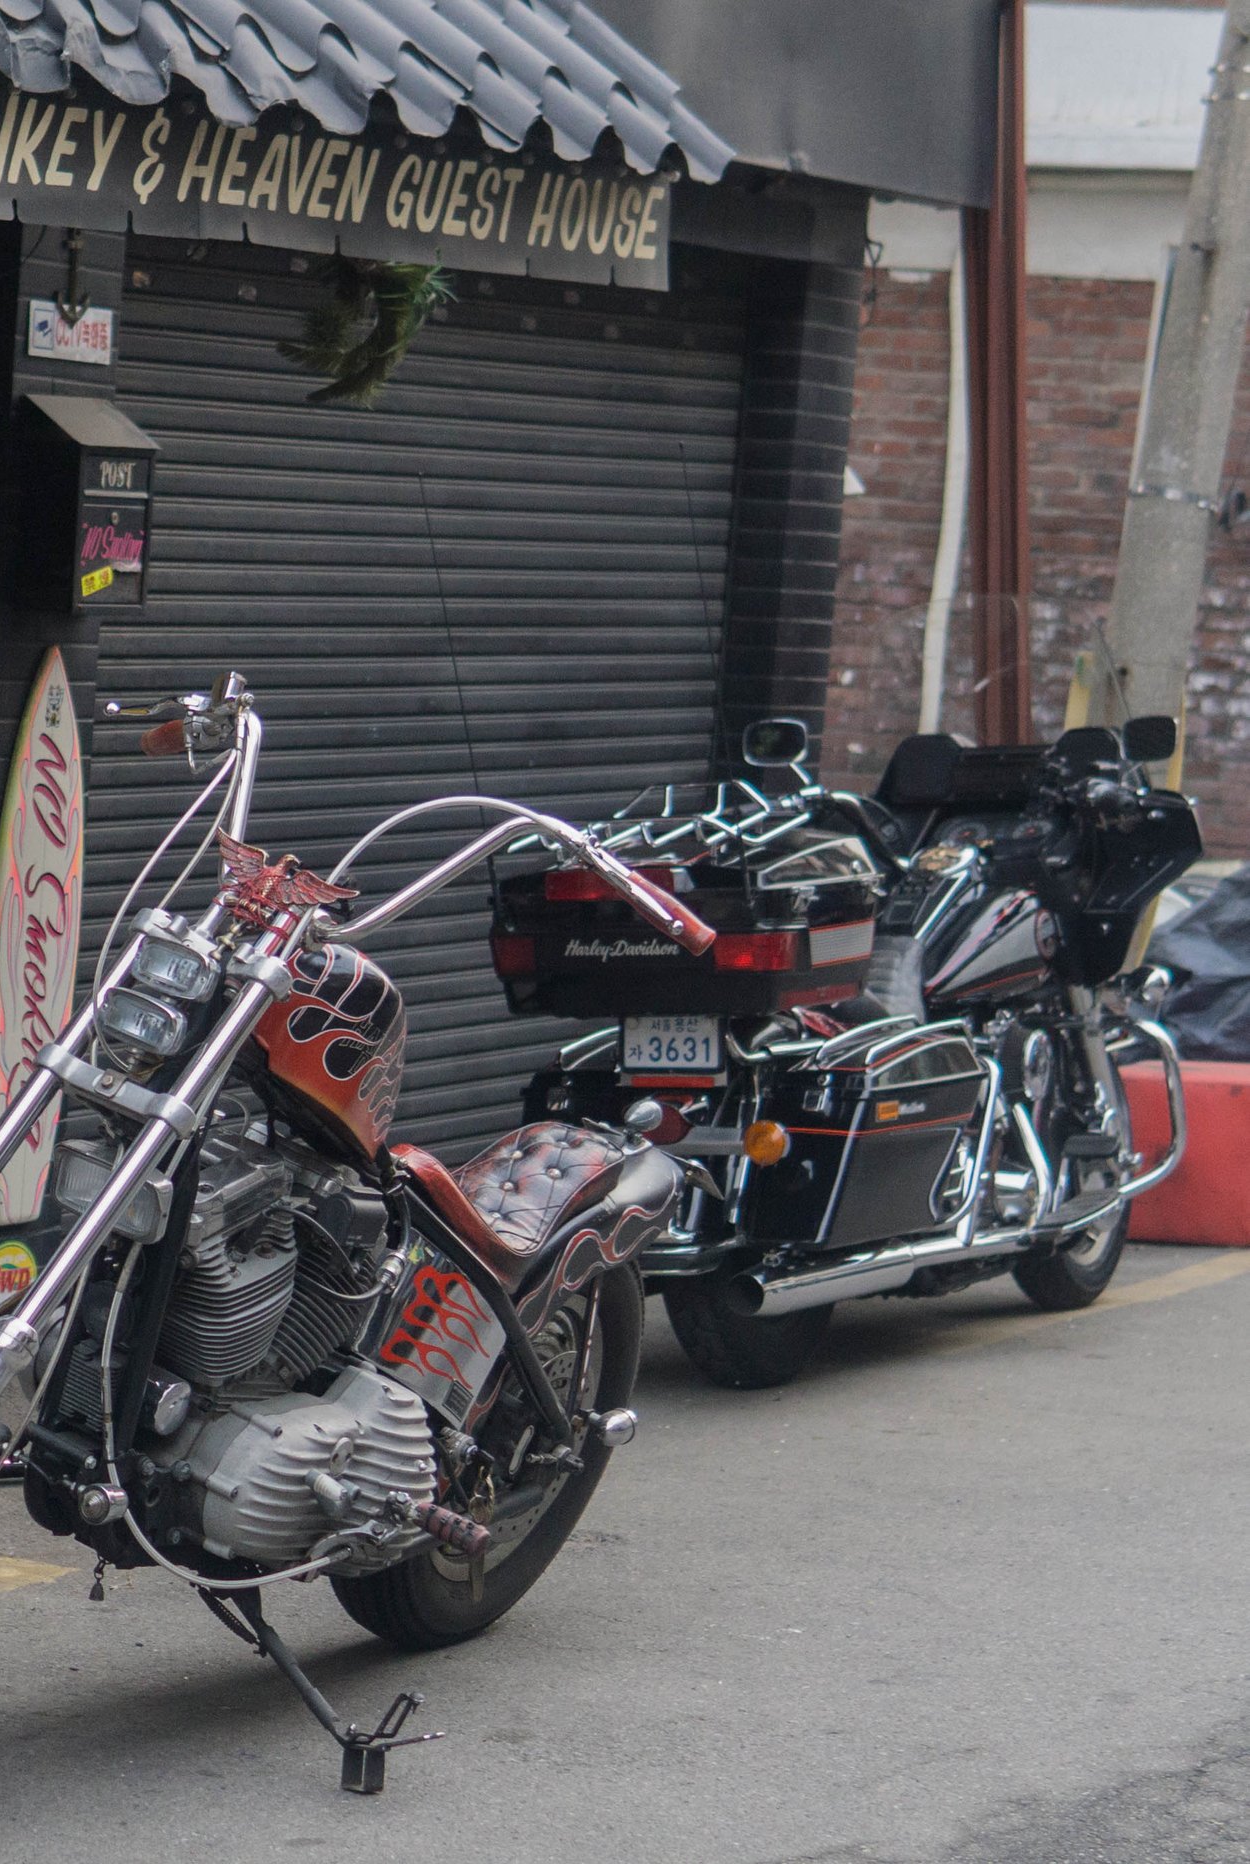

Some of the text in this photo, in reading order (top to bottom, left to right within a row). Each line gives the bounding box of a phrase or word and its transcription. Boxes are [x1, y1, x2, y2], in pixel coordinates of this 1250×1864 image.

[133, 108, 171, 205] &
[177, 119, 381, 224] HEAVEN
[386, 154, 524, 244] GUEST
[527, 171, 666, 261] HOUSE
[100, 460, 137, 490] POST
[32, 732, 67, 849] NO
[564, 939, 680, 963] Harley-Davidson
[628, 1035, 711, 1063] 자 3631
